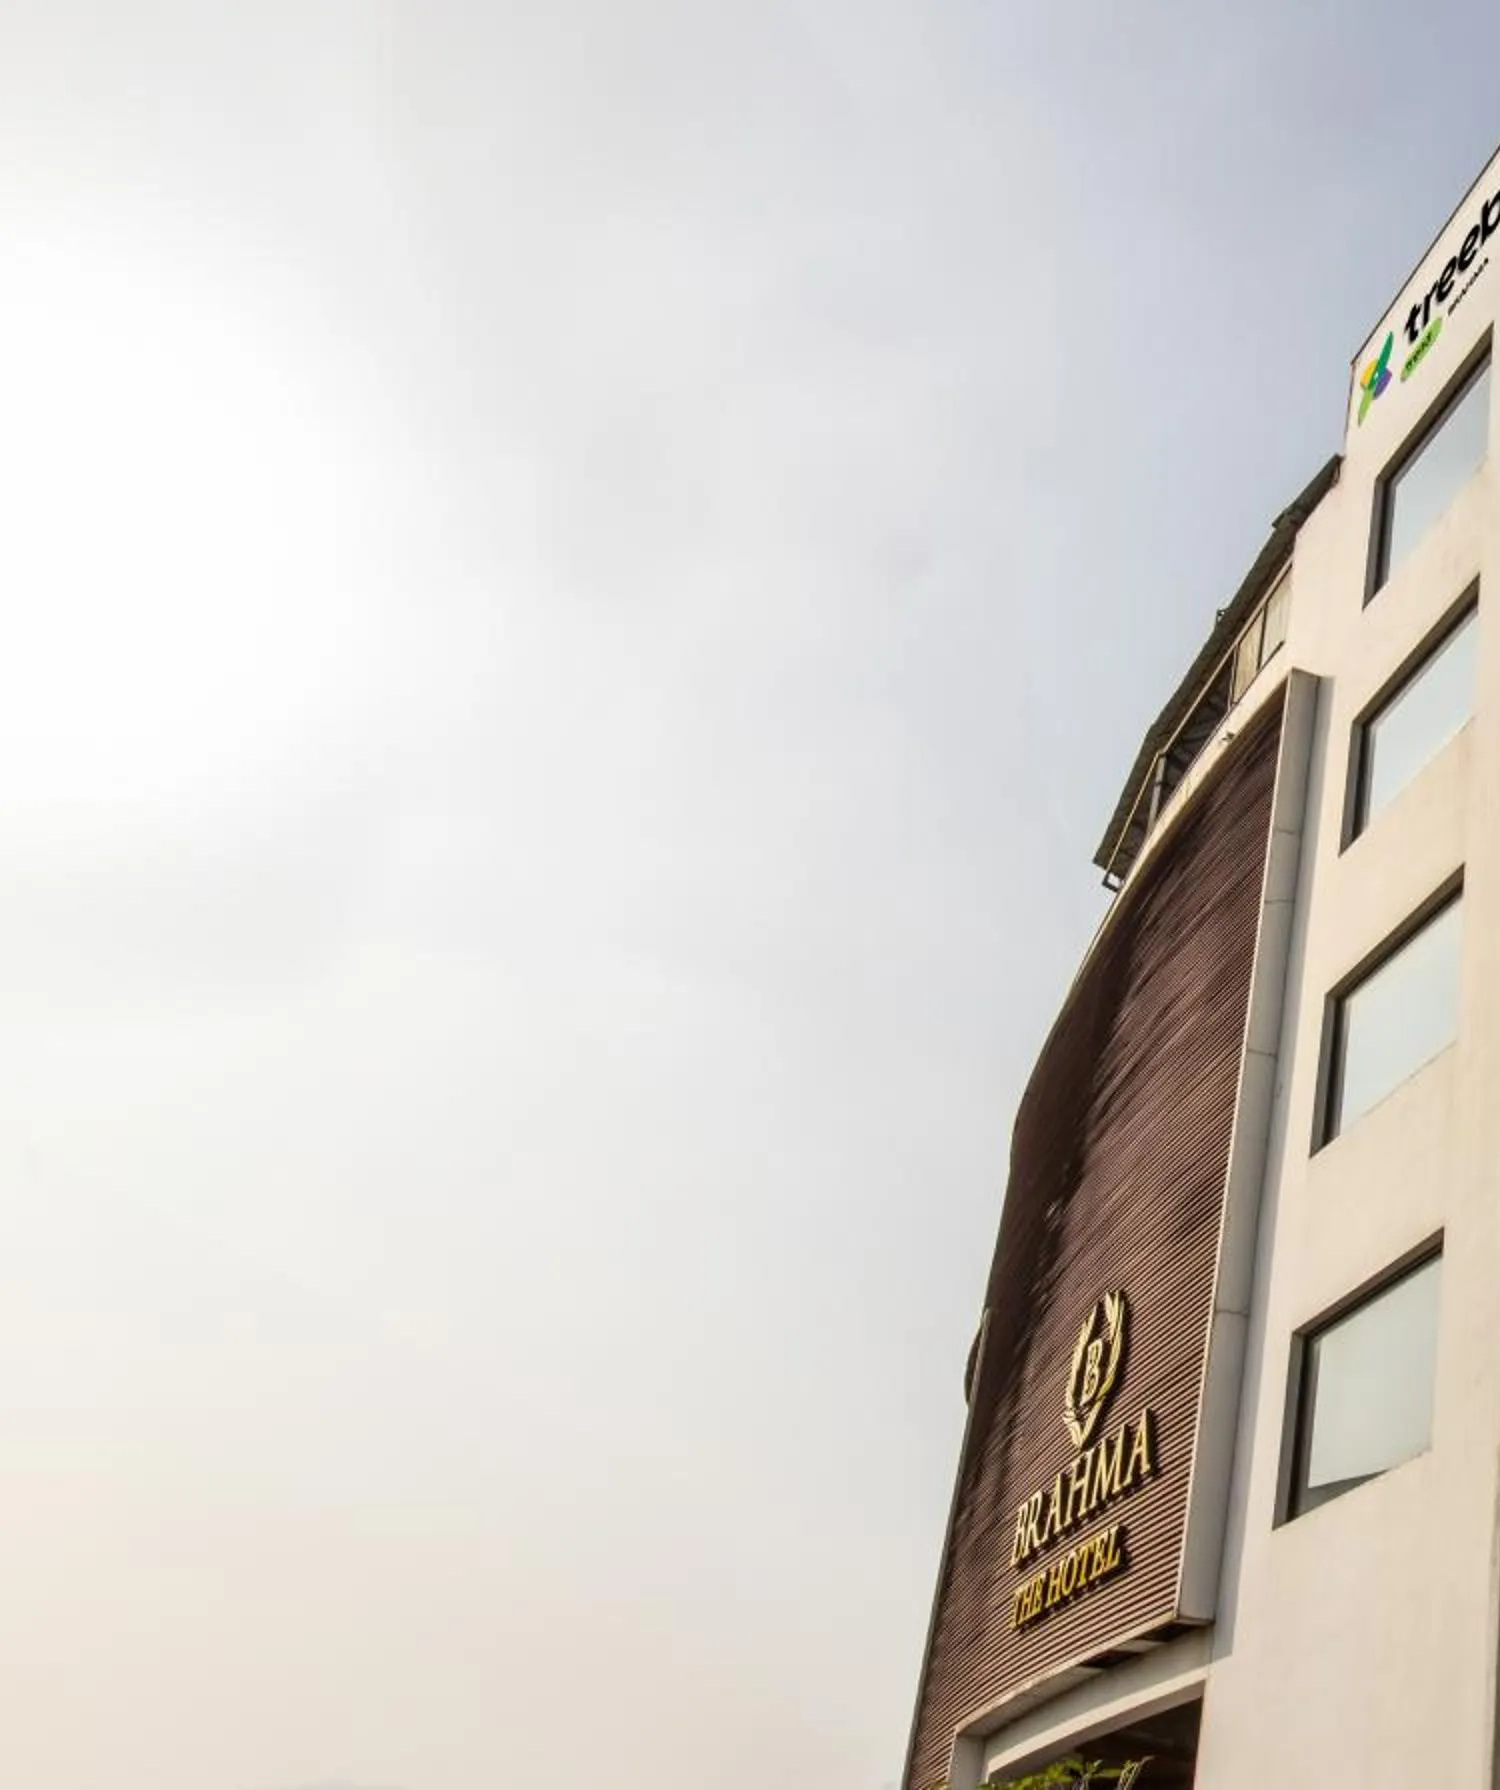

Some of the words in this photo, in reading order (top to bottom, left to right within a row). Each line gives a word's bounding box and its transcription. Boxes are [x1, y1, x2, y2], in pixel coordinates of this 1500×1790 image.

[1011, 1407, 1152, 1568] BRAHMA
[1012, 1571, 1045, 1631] THE
[1046, 1524, 1122, 1605] HOTEL
